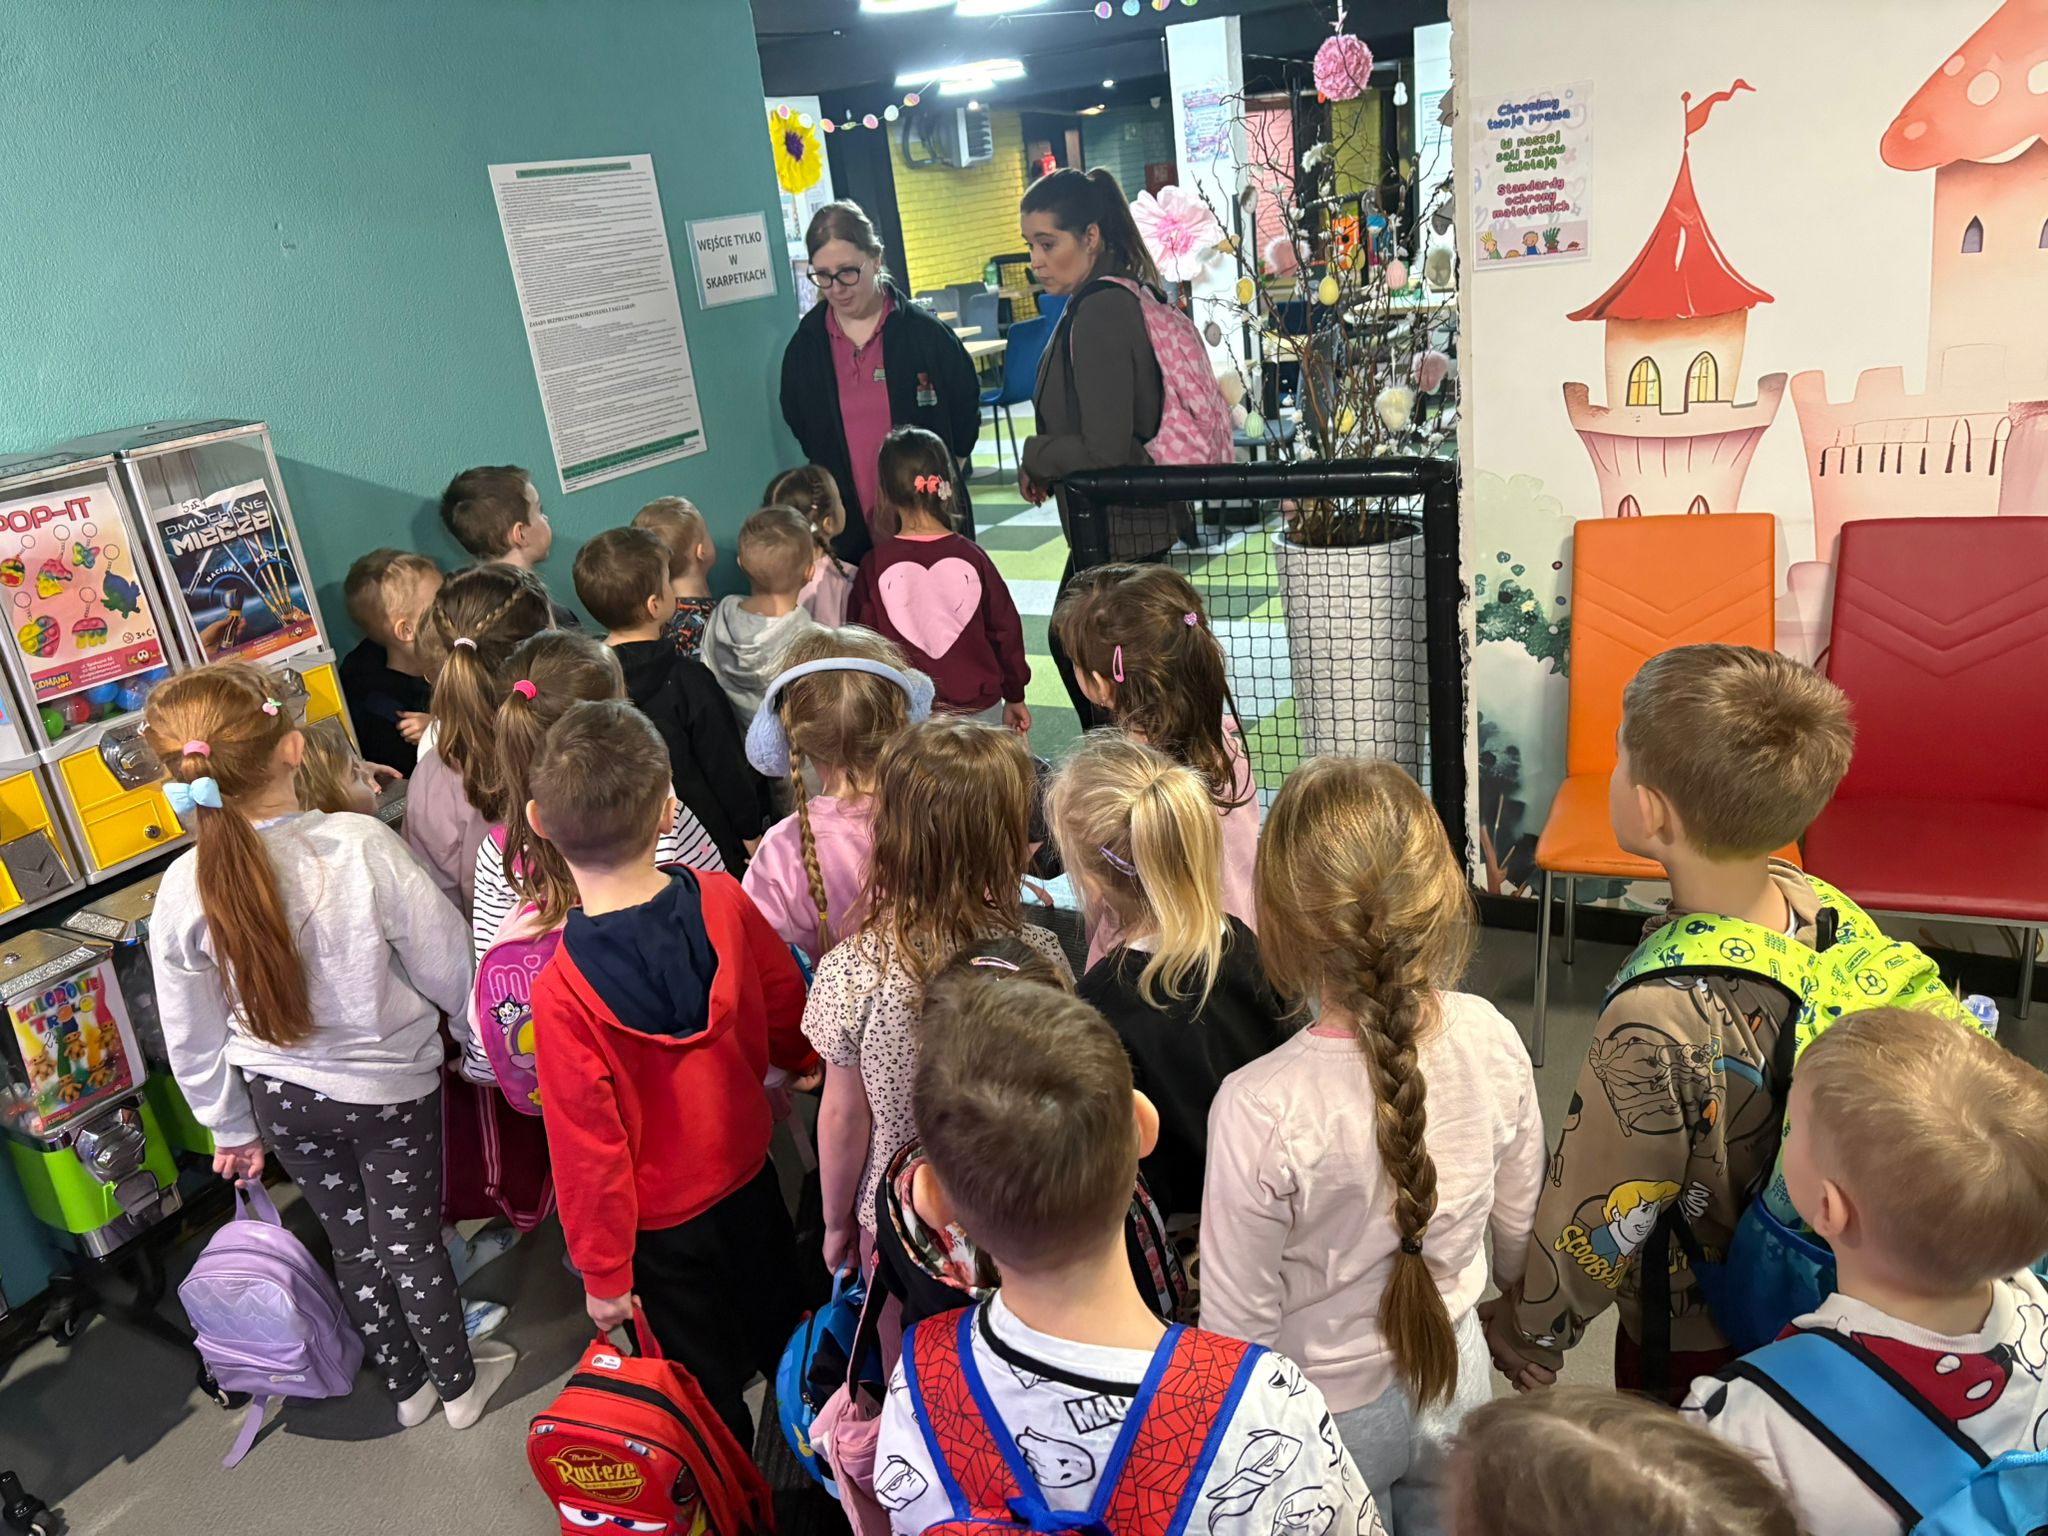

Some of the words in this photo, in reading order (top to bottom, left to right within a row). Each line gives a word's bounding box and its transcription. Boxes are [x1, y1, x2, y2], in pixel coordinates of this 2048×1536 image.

[1487, 114, 1524, 130] twoje
[1529, 109, 1570, 125] prawa
[1517, 130, 1561, 147] naszej
[1496, 148, 1520, 162] sali
[1524, 144, 1566, 159] zabaw
[1497, 177, 1564, 196] Standardy
[1505, 192, 1557, 206] ochrony
[697, 234, 733, 252] WEJŚCIE
[734, 231, 762, 246] TYLKO
[728, 254, 738, 266] W
[706, 268, 767, 289] SKARPETKACH
[165, 499, 264, 536] DMUCHANE
